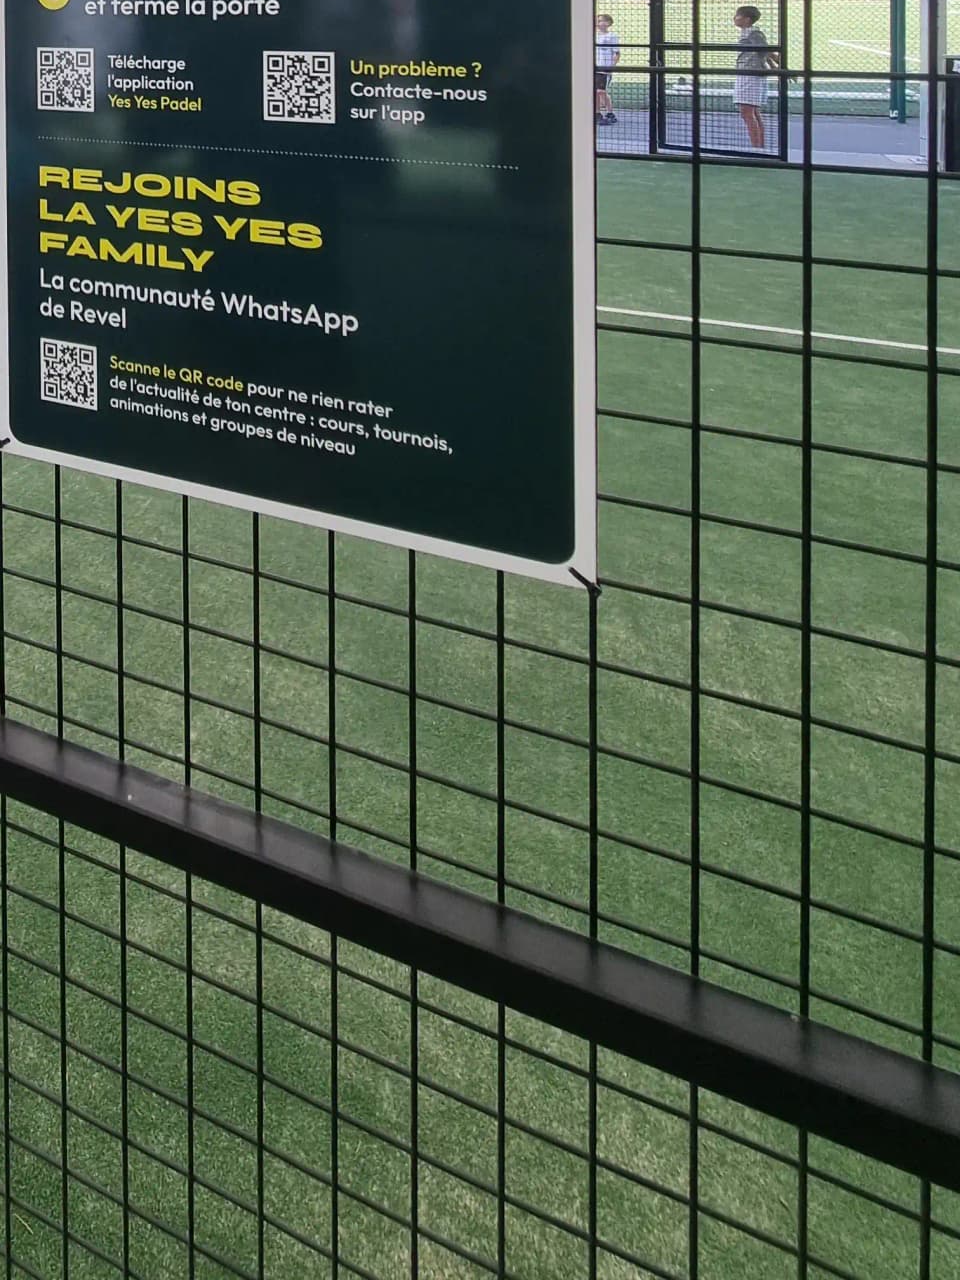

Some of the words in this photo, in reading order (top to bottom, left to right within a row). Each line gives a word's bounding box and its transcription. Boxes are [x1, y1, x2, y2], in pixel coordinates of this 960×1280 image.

[107, 54, 186, 73] Télécharge
[350, 60, 375, 77] Un
[378, 60, 467, 81] problème
[107, 74, 194, 92] l'application
[350, 82, 488, 102] Contacte-nous
[108, 94, 131, 108] Yes
[134, 95, 157, 109] Yes
[160, 96, 201, 111] Padel
[350, 105, 378, 120] sur
[381, 104, 425, 124] l'app
[39, 165, 261, 206] REJOINS
[39, 199, 97, 227] LA
[105, 204, 204, 237] YES
[214, 215, 324, 249] YES
[39, 231, 215, 273] FAMILY
[40, 268, 64, 291] La
[69, 277, 215, 312] communauté
[221, 291, 359, 337] WhatsApp
[40, 297, 64, 319] de
[70, 301, 127, 329] Revel
[110, 355, 160, 376] Scanne
[164, 364, 176, 379] le
[179, 368, 203, 385] QR
[207, 376, 244, 392] code
[247, 383, 284, 399] pour
[288, 389, 308, 403] ne
[312, 392, 344, 410] rien
[348, 400, 393, 418] rater
[109, 375, 127, 390] de
[130, 378, 199, 404] l'actualité
[203, 392, 222, 408] de
[225, 397, 251, 414] ton
[254, 404, 306, 424] centre
[318, 417, 369, 439] cours,
[373, 424, 453, 455] tournois,
[110, 397, 189, 422] animations
[192, 412, 207, 426] et
[211, 417, 273, 439] groupes
[277, 428, 297, 443] de
[301, 433, 355, 455] niveau
